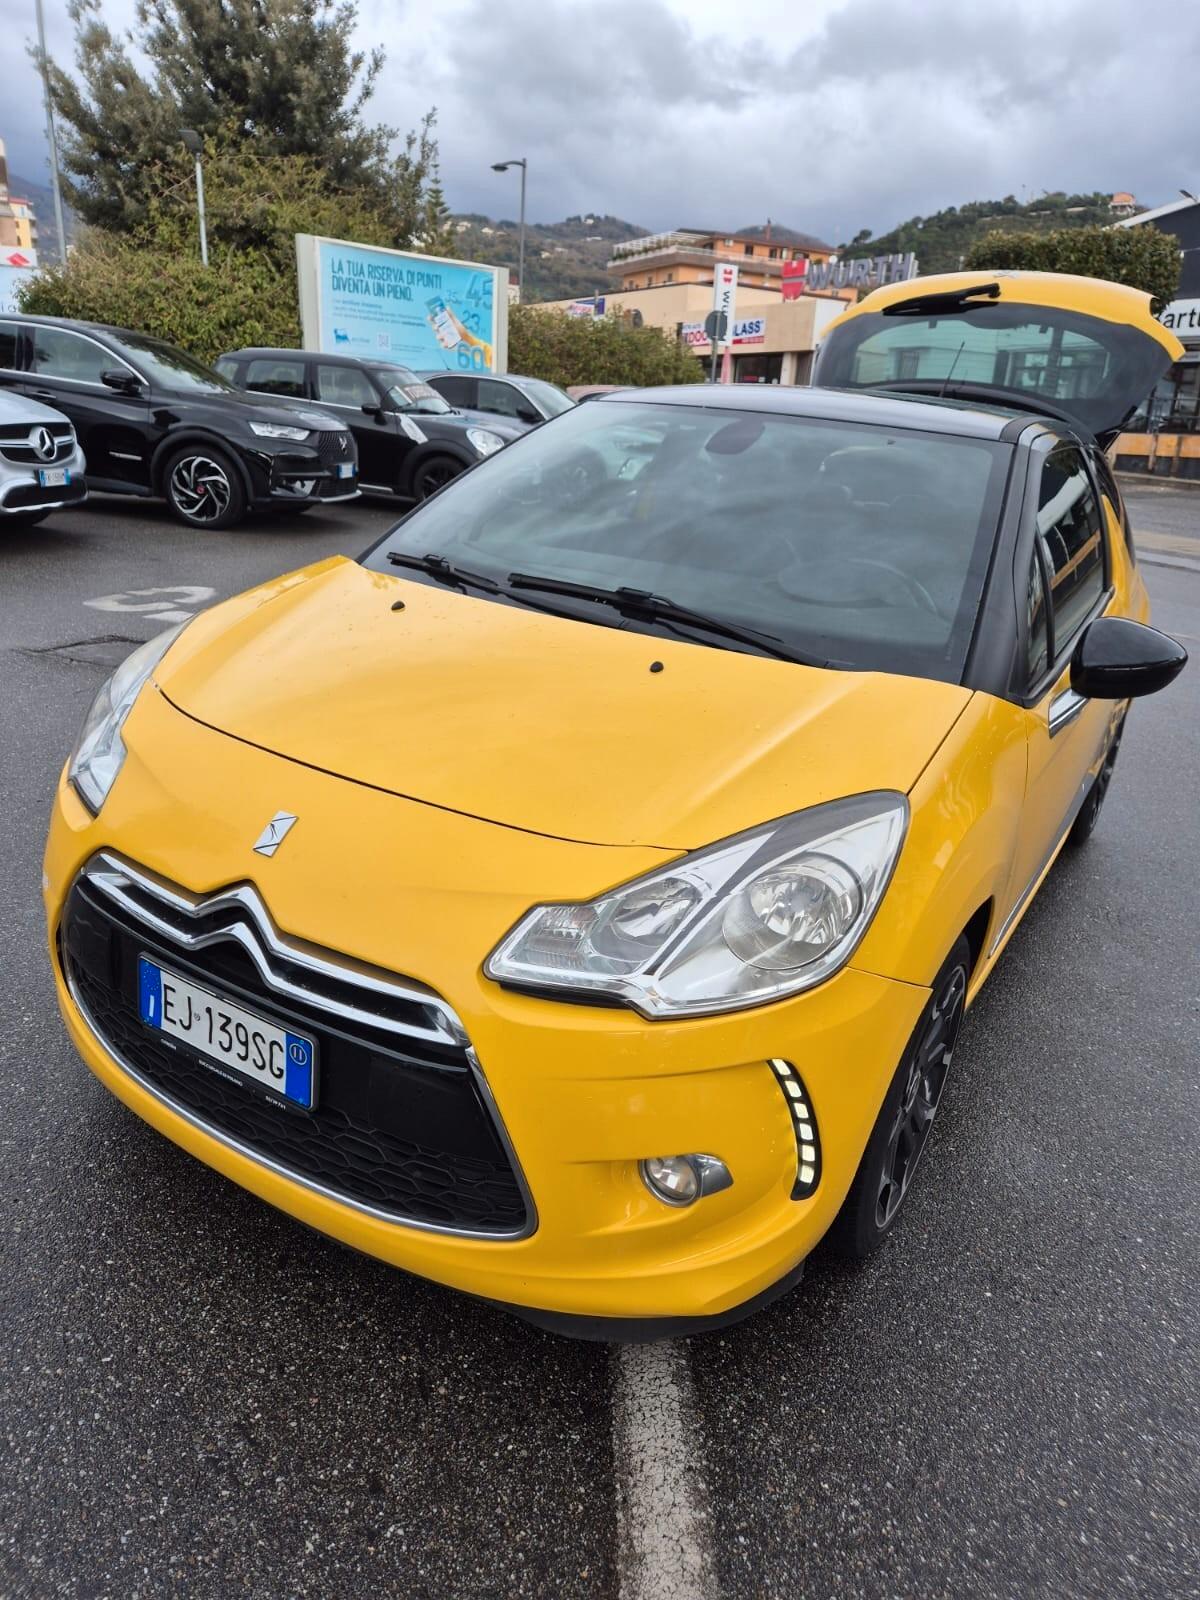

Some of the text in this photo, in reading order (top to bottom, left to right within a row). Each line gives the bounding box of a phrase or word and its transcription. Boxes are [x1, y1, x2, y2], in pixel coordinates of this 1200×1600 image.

[331, 258, 442, 289] LA TUA RISERVA DI PUNTI
[332, 275, 371, 296] DIVENTA
[373, 283, 385, 298] UN
[732, 319, 761, 338] LASS
[457, 343, 484, 371] 60
[163, 984, 192, 1031] EJ
[205, 1006, 284, 1079] 139SG
